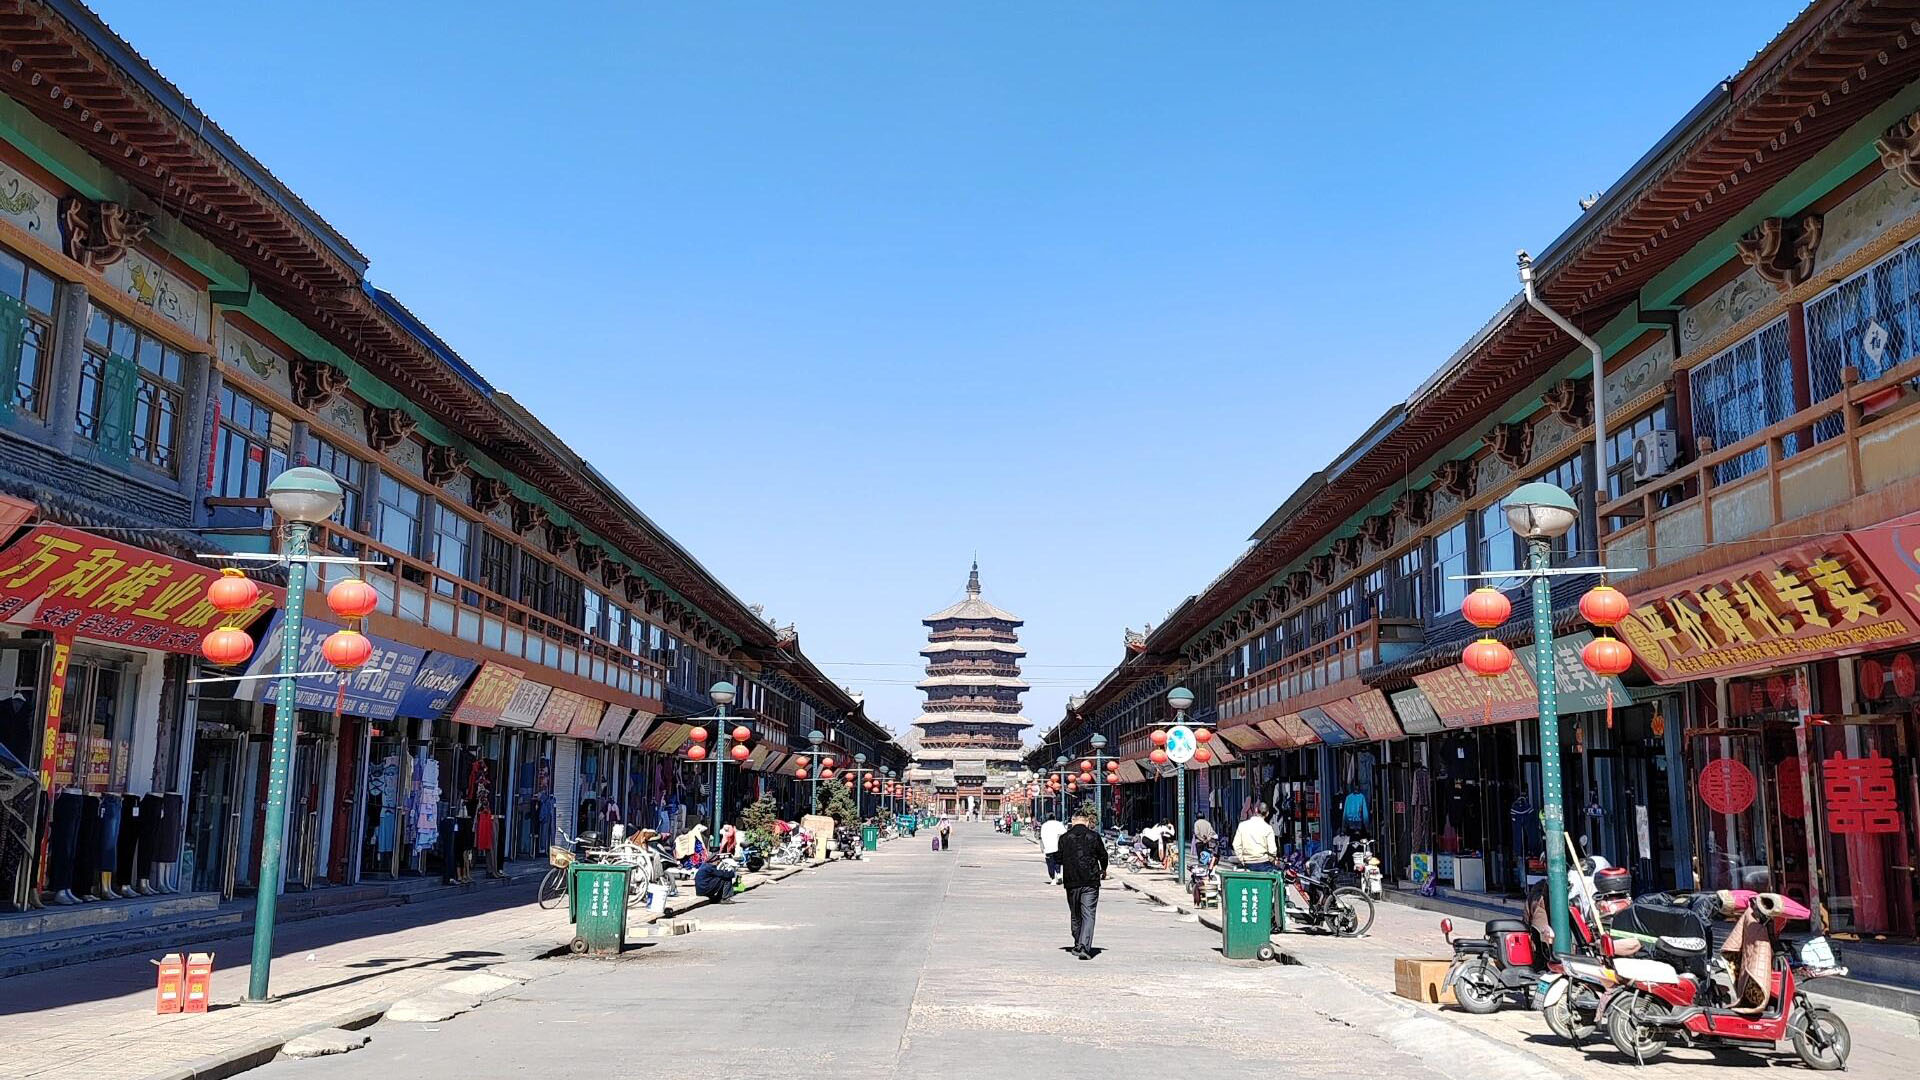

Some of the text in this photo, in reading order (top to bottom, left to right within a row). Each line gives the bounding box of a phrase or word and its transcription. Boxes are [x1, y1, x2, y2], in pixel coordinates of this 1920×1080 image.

[1635, 558, 1880, 655] 平价婚礼专卖
